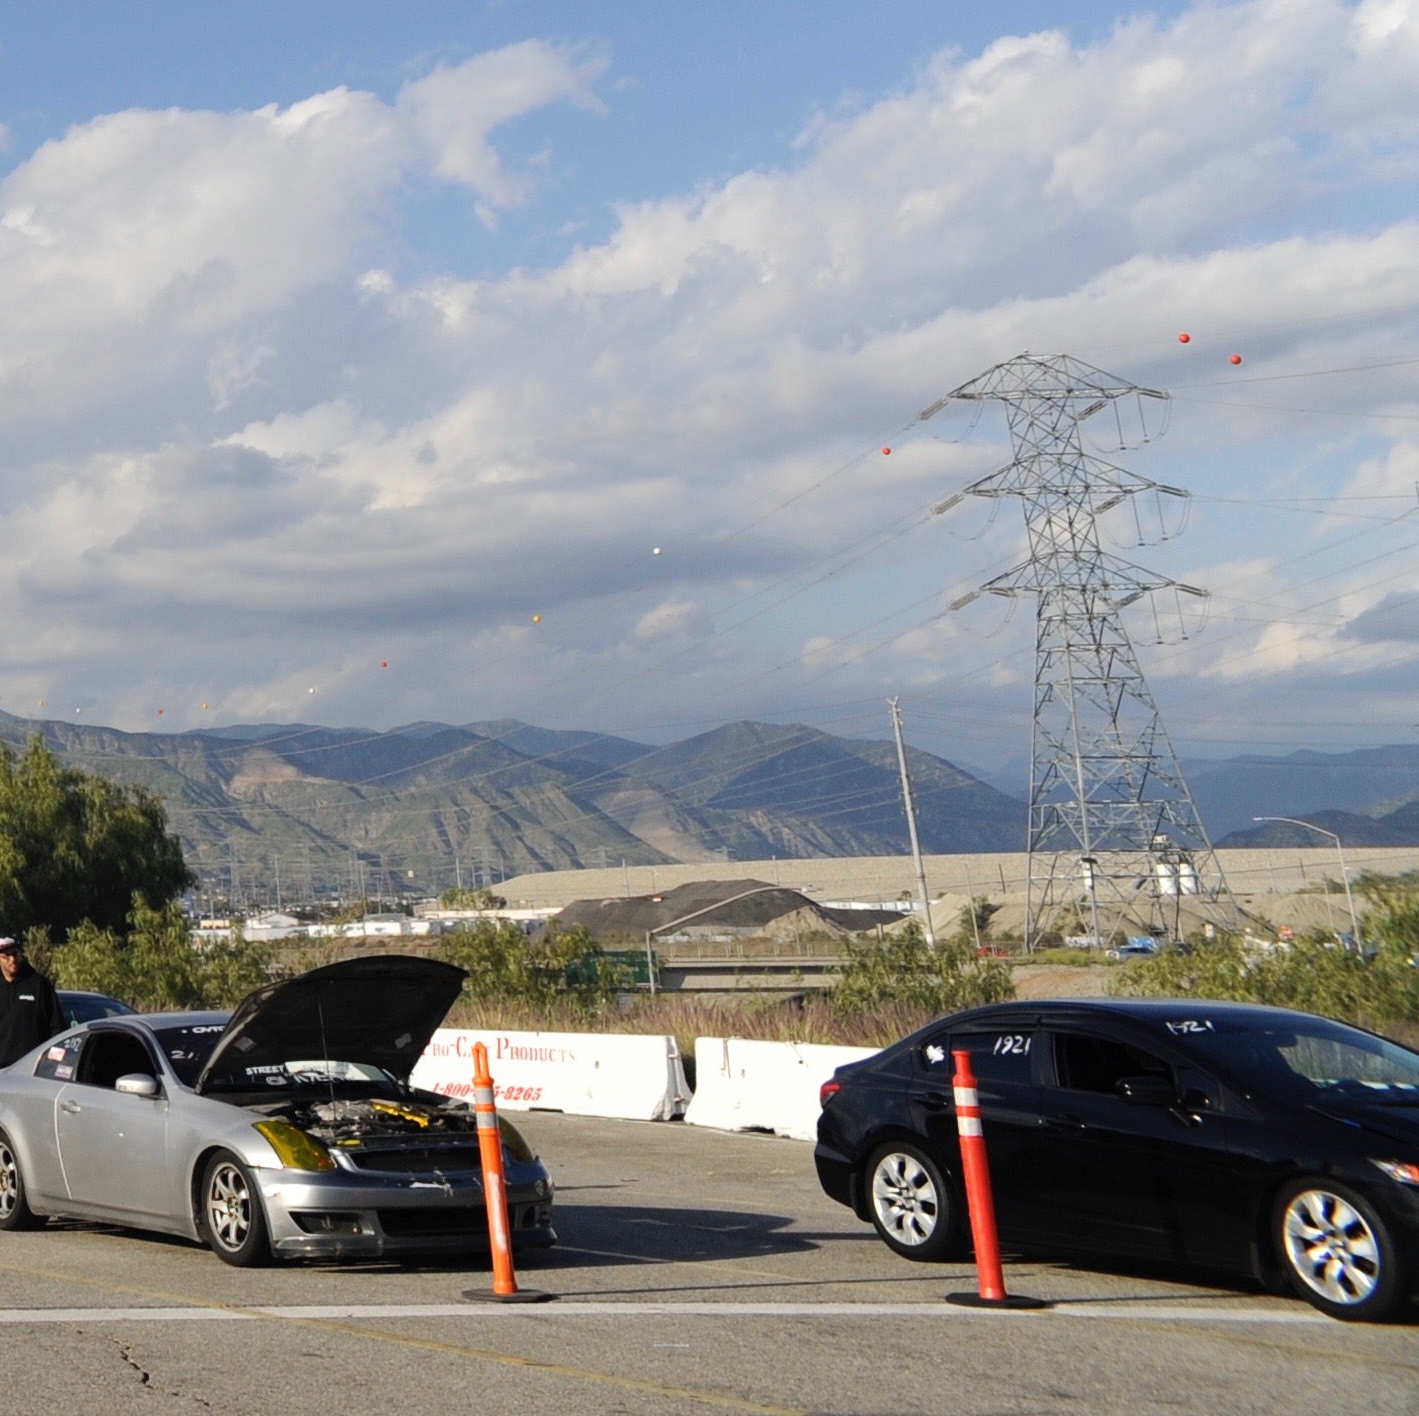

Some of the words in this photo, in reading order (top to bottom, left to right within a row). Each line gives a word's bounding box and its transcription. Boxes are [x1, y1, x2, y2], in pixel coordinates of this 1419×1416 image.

[1165, 1020, 1215, 1035] 1921
[992, 1035, 1032, 1056] 1921
[244, 1065, 285, 1076] STREET
